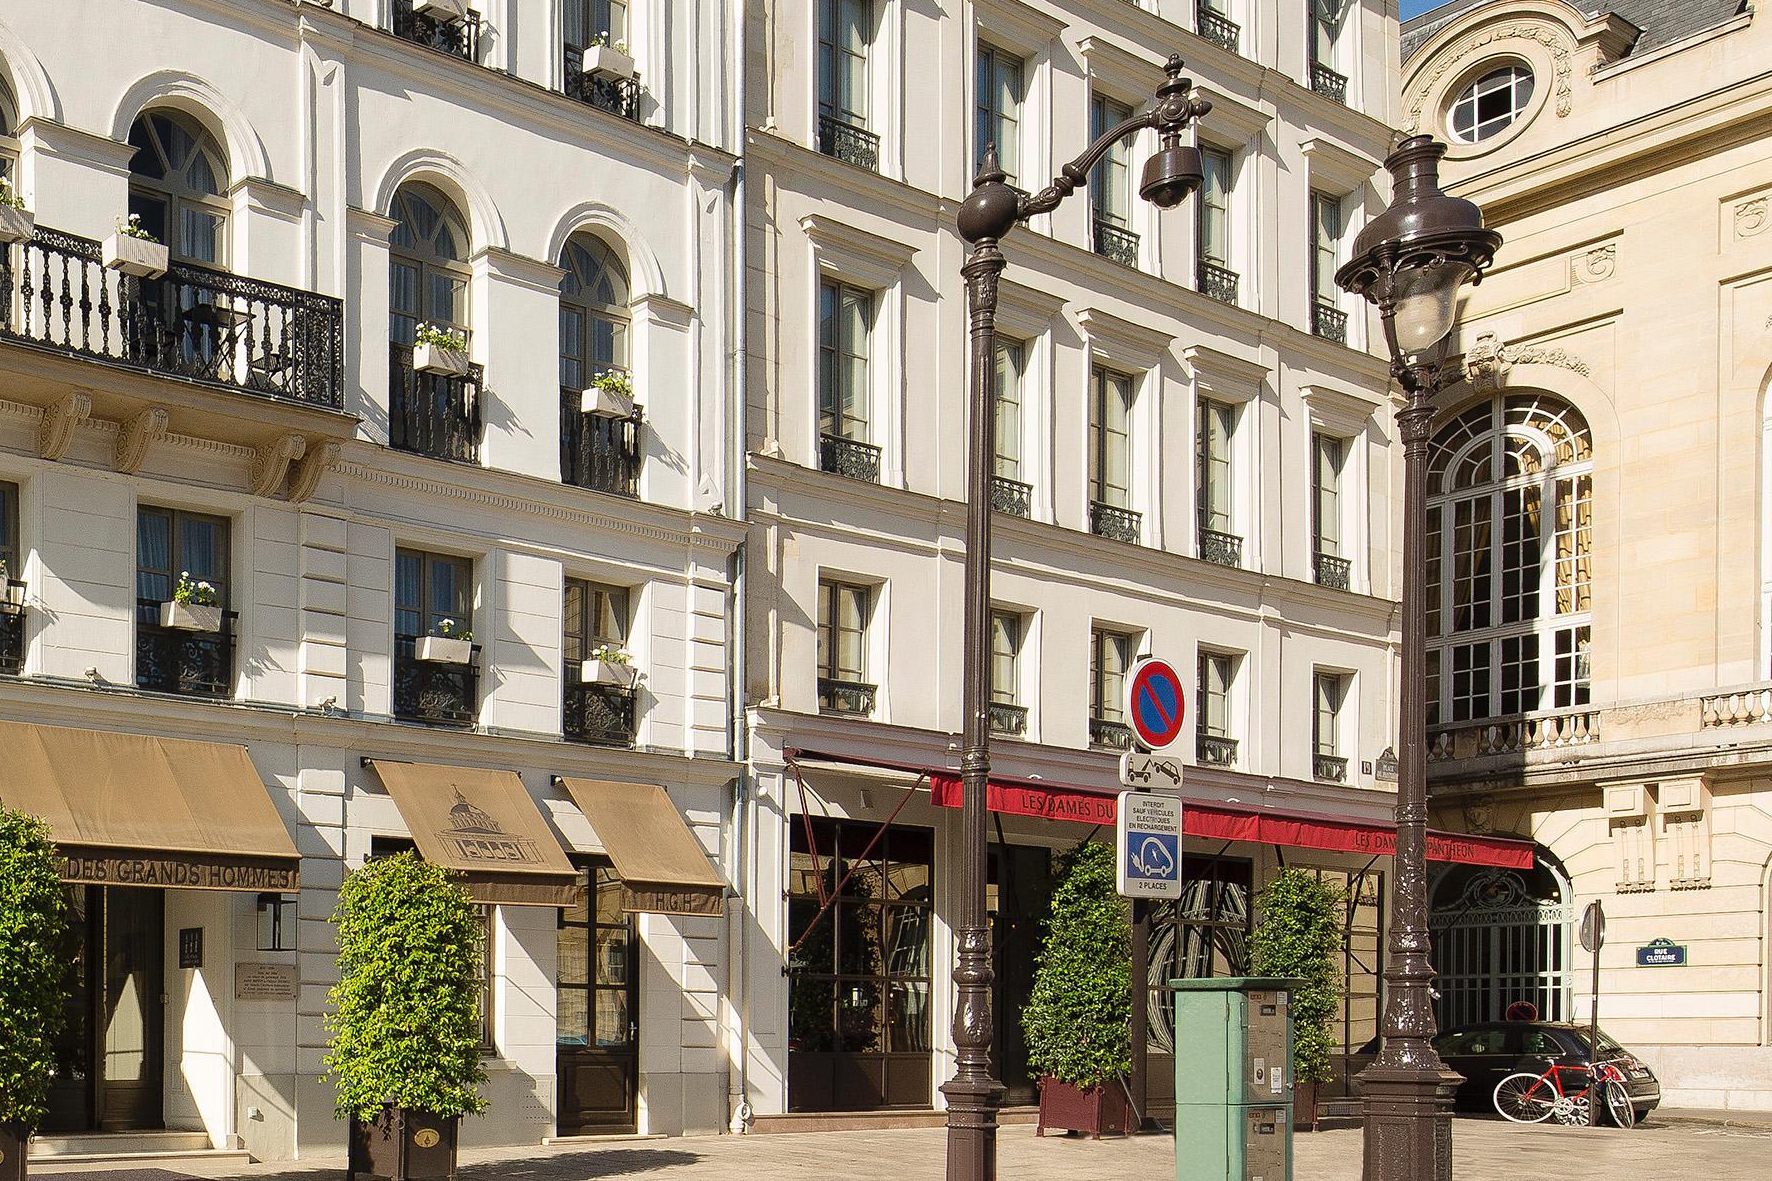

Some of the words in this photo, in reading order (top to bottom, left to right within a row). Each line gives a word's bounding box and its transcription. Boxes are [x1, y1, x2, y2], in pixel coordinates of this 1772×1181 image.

[1022, 794, 1044, 811] LES
[1048, 798, 1091, 816] DAMES
[1097, 803, 1114, 819] DU
[1142, 801, 1165, 809] INTERDIT
[1133, 807, 1147, 816] SAUF
[1147, 808, 1174, 818] VEHICULES
[1136, 816, 1170, 824] ELECTRIQUES
[1137, 823, 1177, 832] RECHARGEMENT
[1356, 832, 1370, 848] LES
[1375, 835, 1397, 850] DAM
[1427, 840, 1475, 858] PANTHEON
[67, 859, 107, 880] DES
[117, 860, 200, 885] GRANDS
[210, 865, 288, 889] HOMMES
[1144, 882, 1168, 890] PLACES
